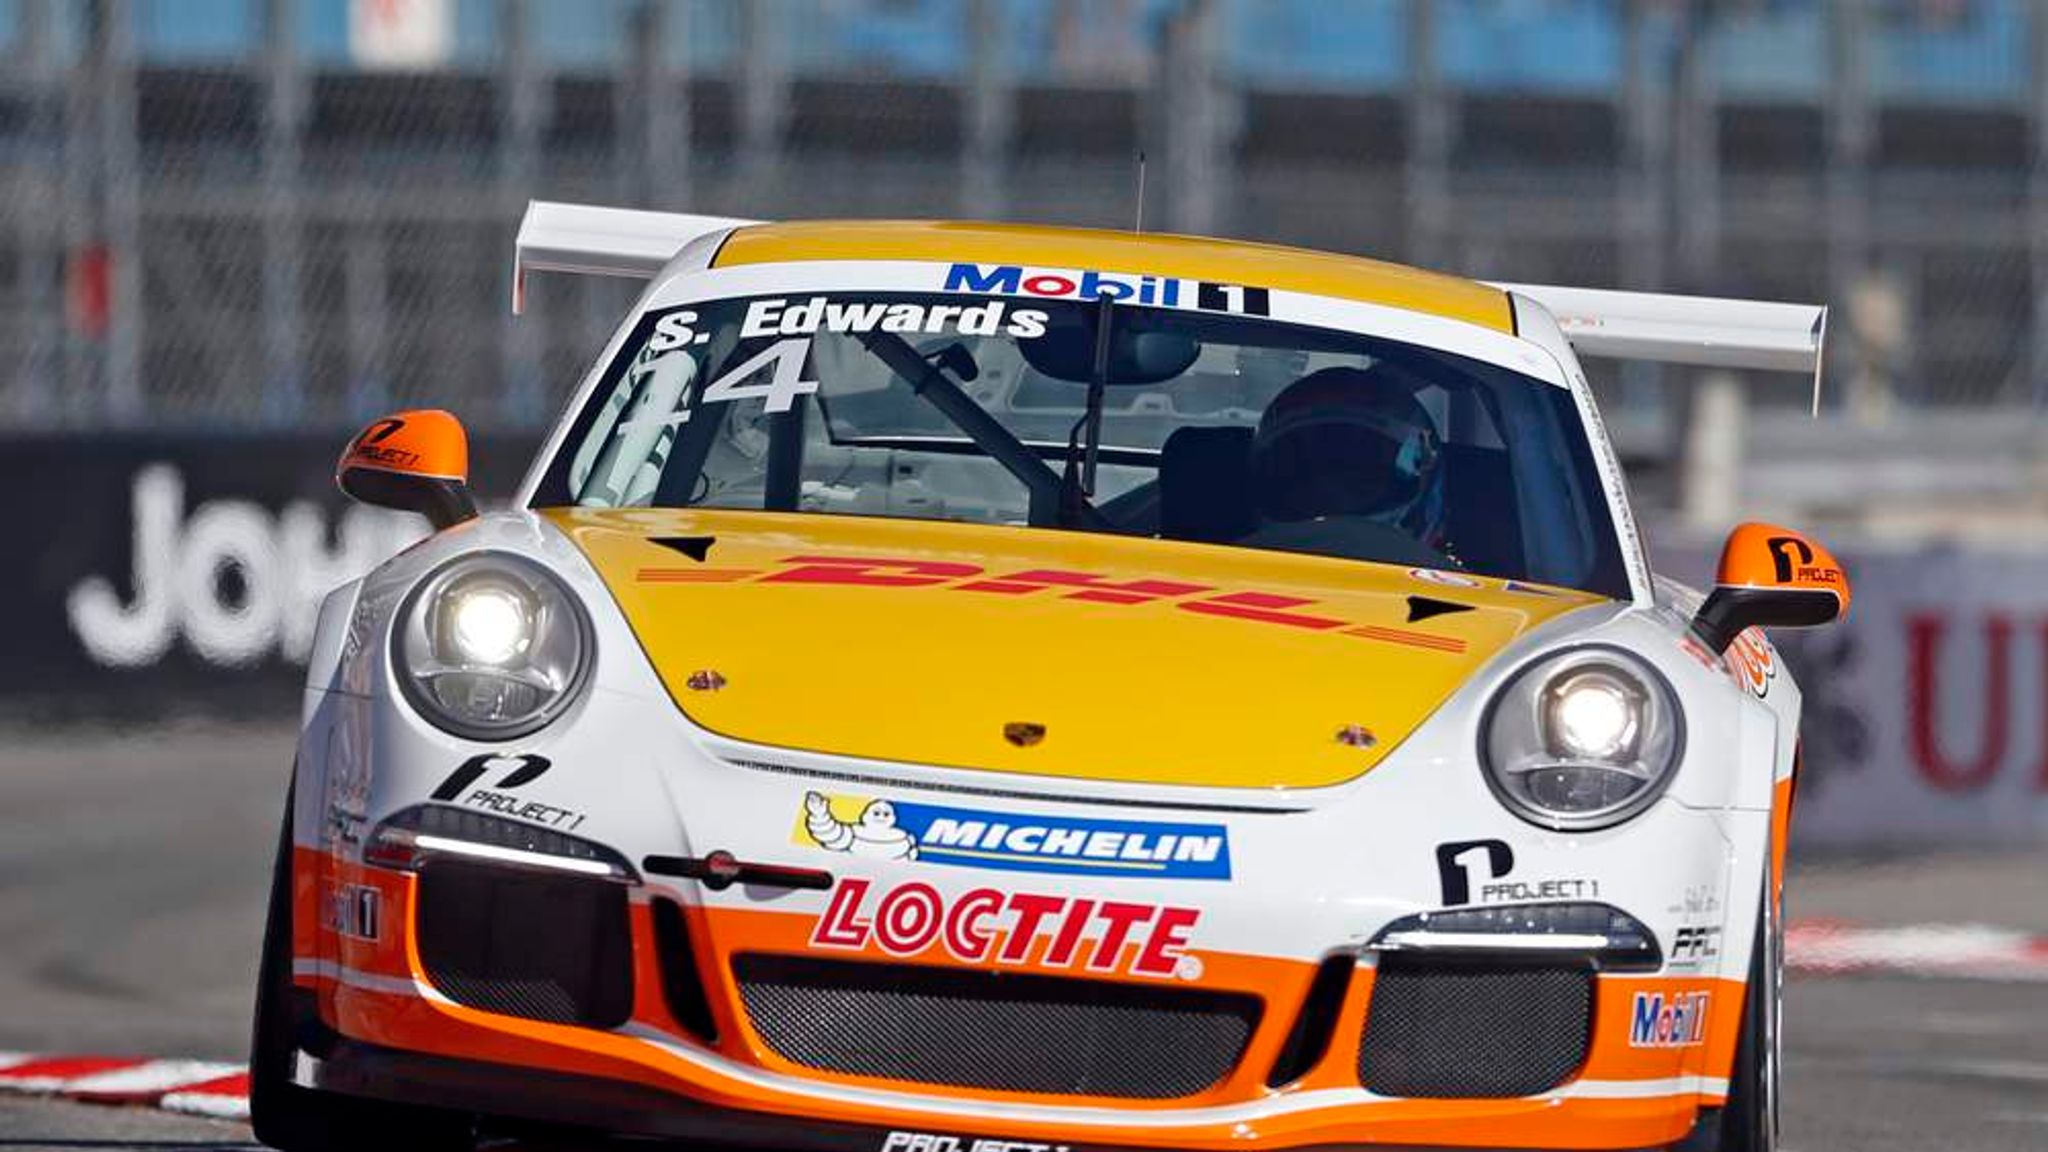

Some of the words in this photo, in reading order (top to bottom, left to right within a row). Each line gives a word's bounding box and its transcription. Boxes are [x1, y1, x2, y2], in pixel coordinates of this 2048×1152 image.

[943, 263, 1179, 306] Mobil
[649, 310, 711, 352] S.
[740, 298, 1049, 339] Edwards
[757, 555, 1348, 631] DHL
[464, 790, 573, 825] PROJECT
[922, 818, 1221, 862] MICHELIN
[1481, 880, 1584, 902] PROJECT
[812, 877, 1201, 977] LOCTITE
